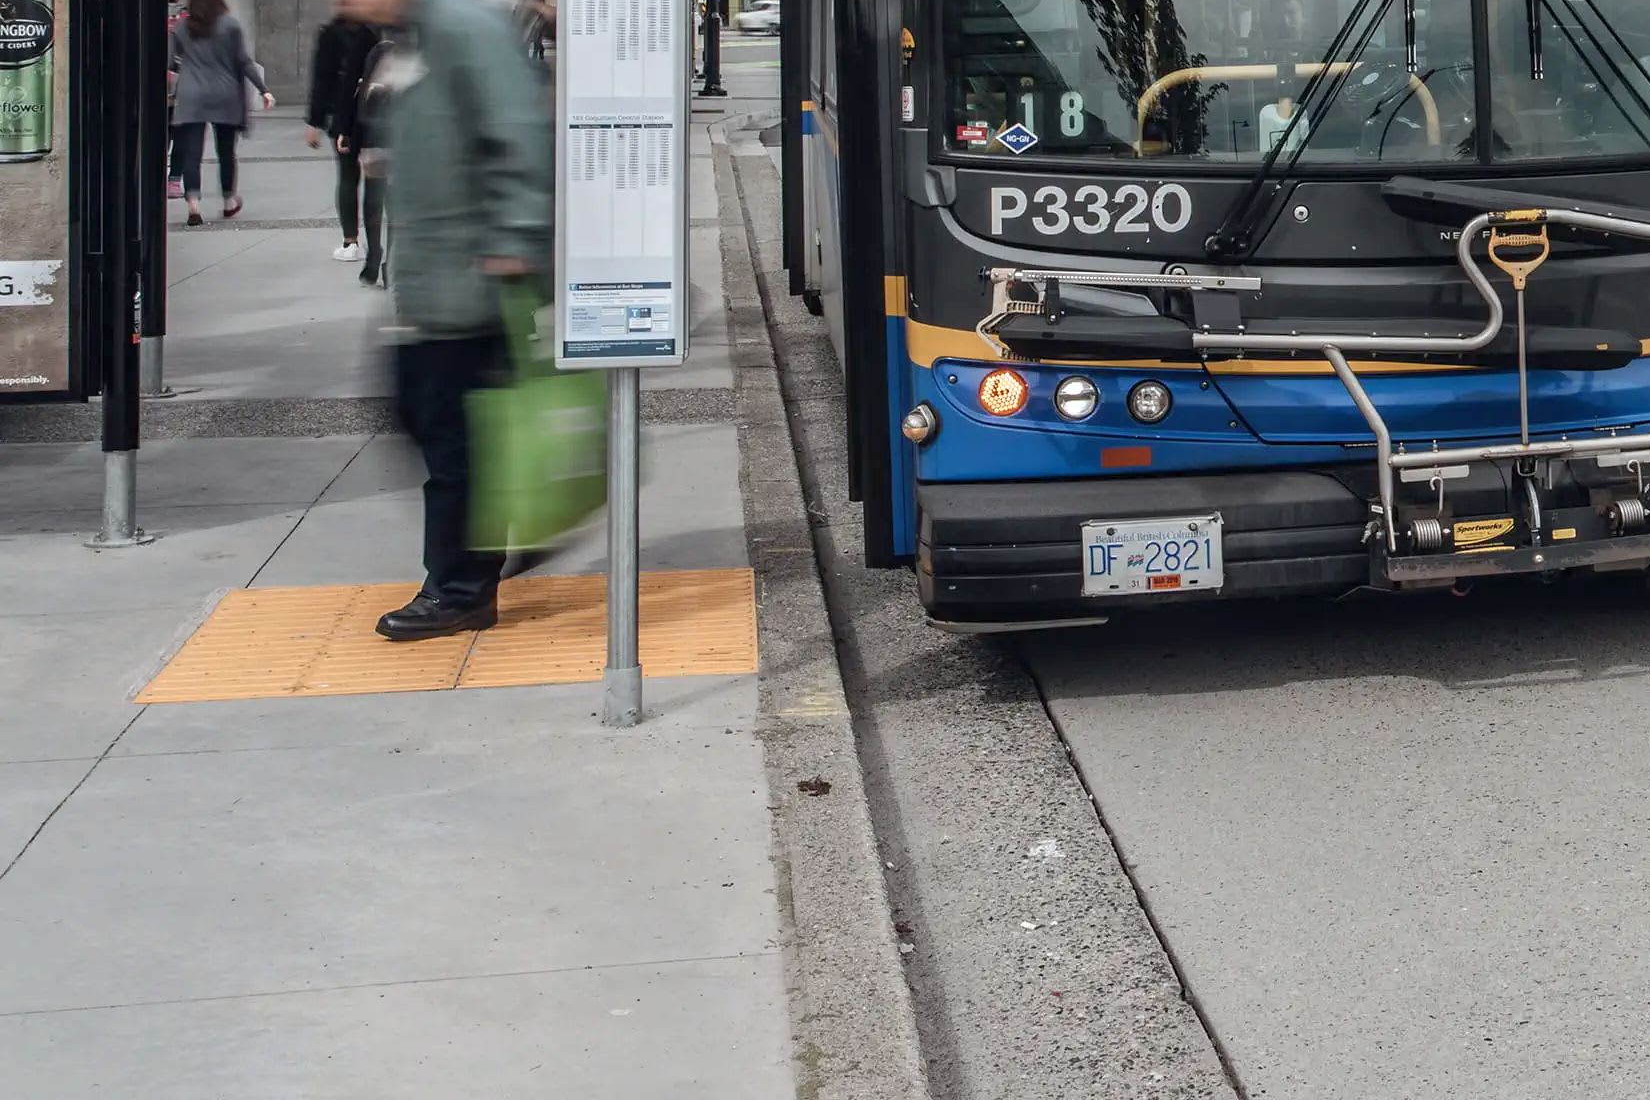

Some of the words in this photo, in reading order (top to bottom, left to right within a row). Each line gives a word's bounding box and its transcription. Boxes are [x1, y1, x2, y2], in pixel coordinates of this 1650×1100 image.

[8, 41, 37, 49] CIDERS
[1006, 135, 1030, 143] NG-GN
[990, 183, 1192, 236] P3320
[1456, 523, 1502, 534] Sportworks
[1089, 544, 1124, 576] DF
[1145, 538, 1211, 574] 2821
